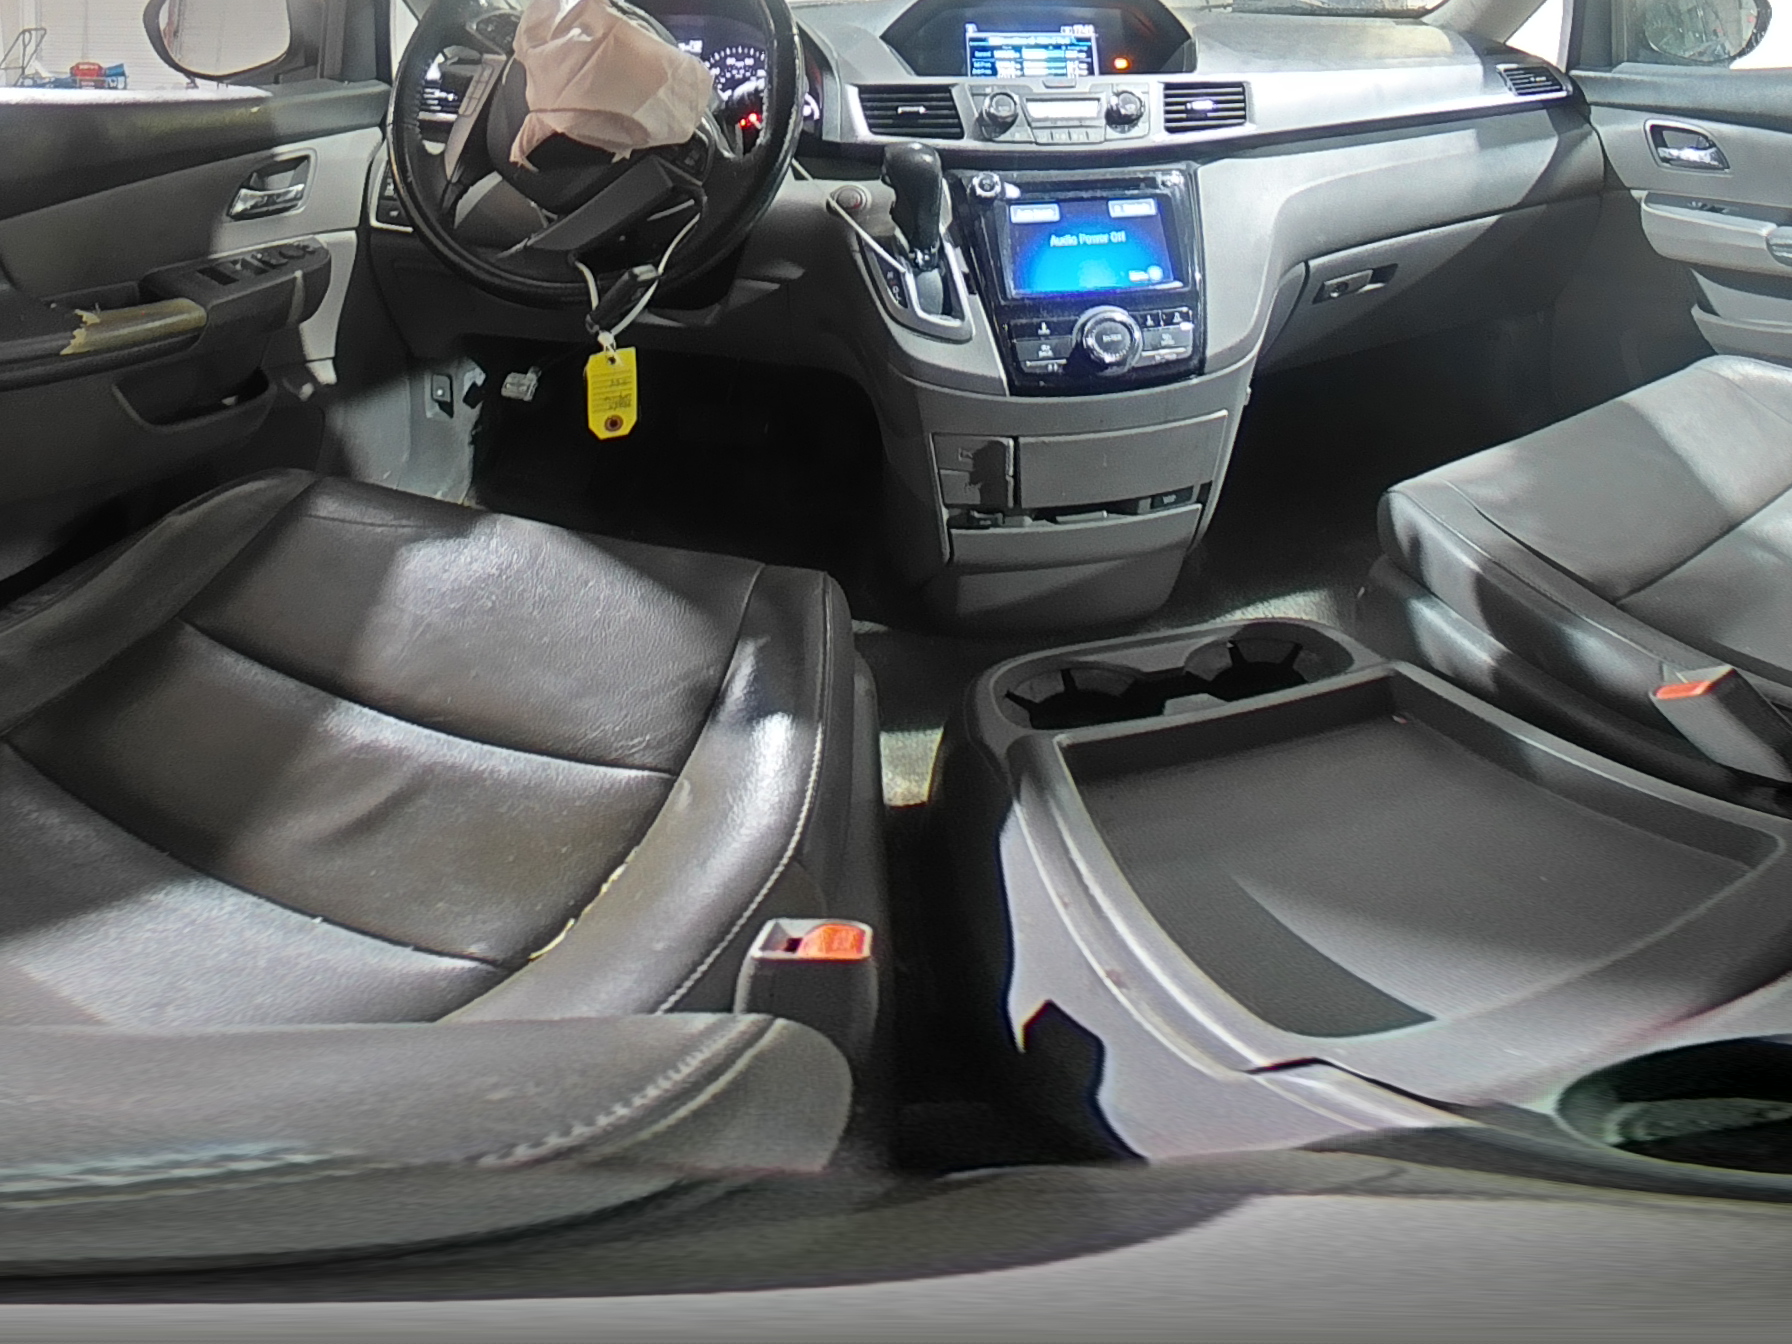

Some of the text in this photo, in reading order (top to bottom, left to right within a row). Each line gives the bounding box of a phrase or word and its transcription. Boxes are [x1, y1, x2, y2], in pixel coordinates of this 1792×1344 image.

[1050, 230, 1127, 247] Audio Power Off
